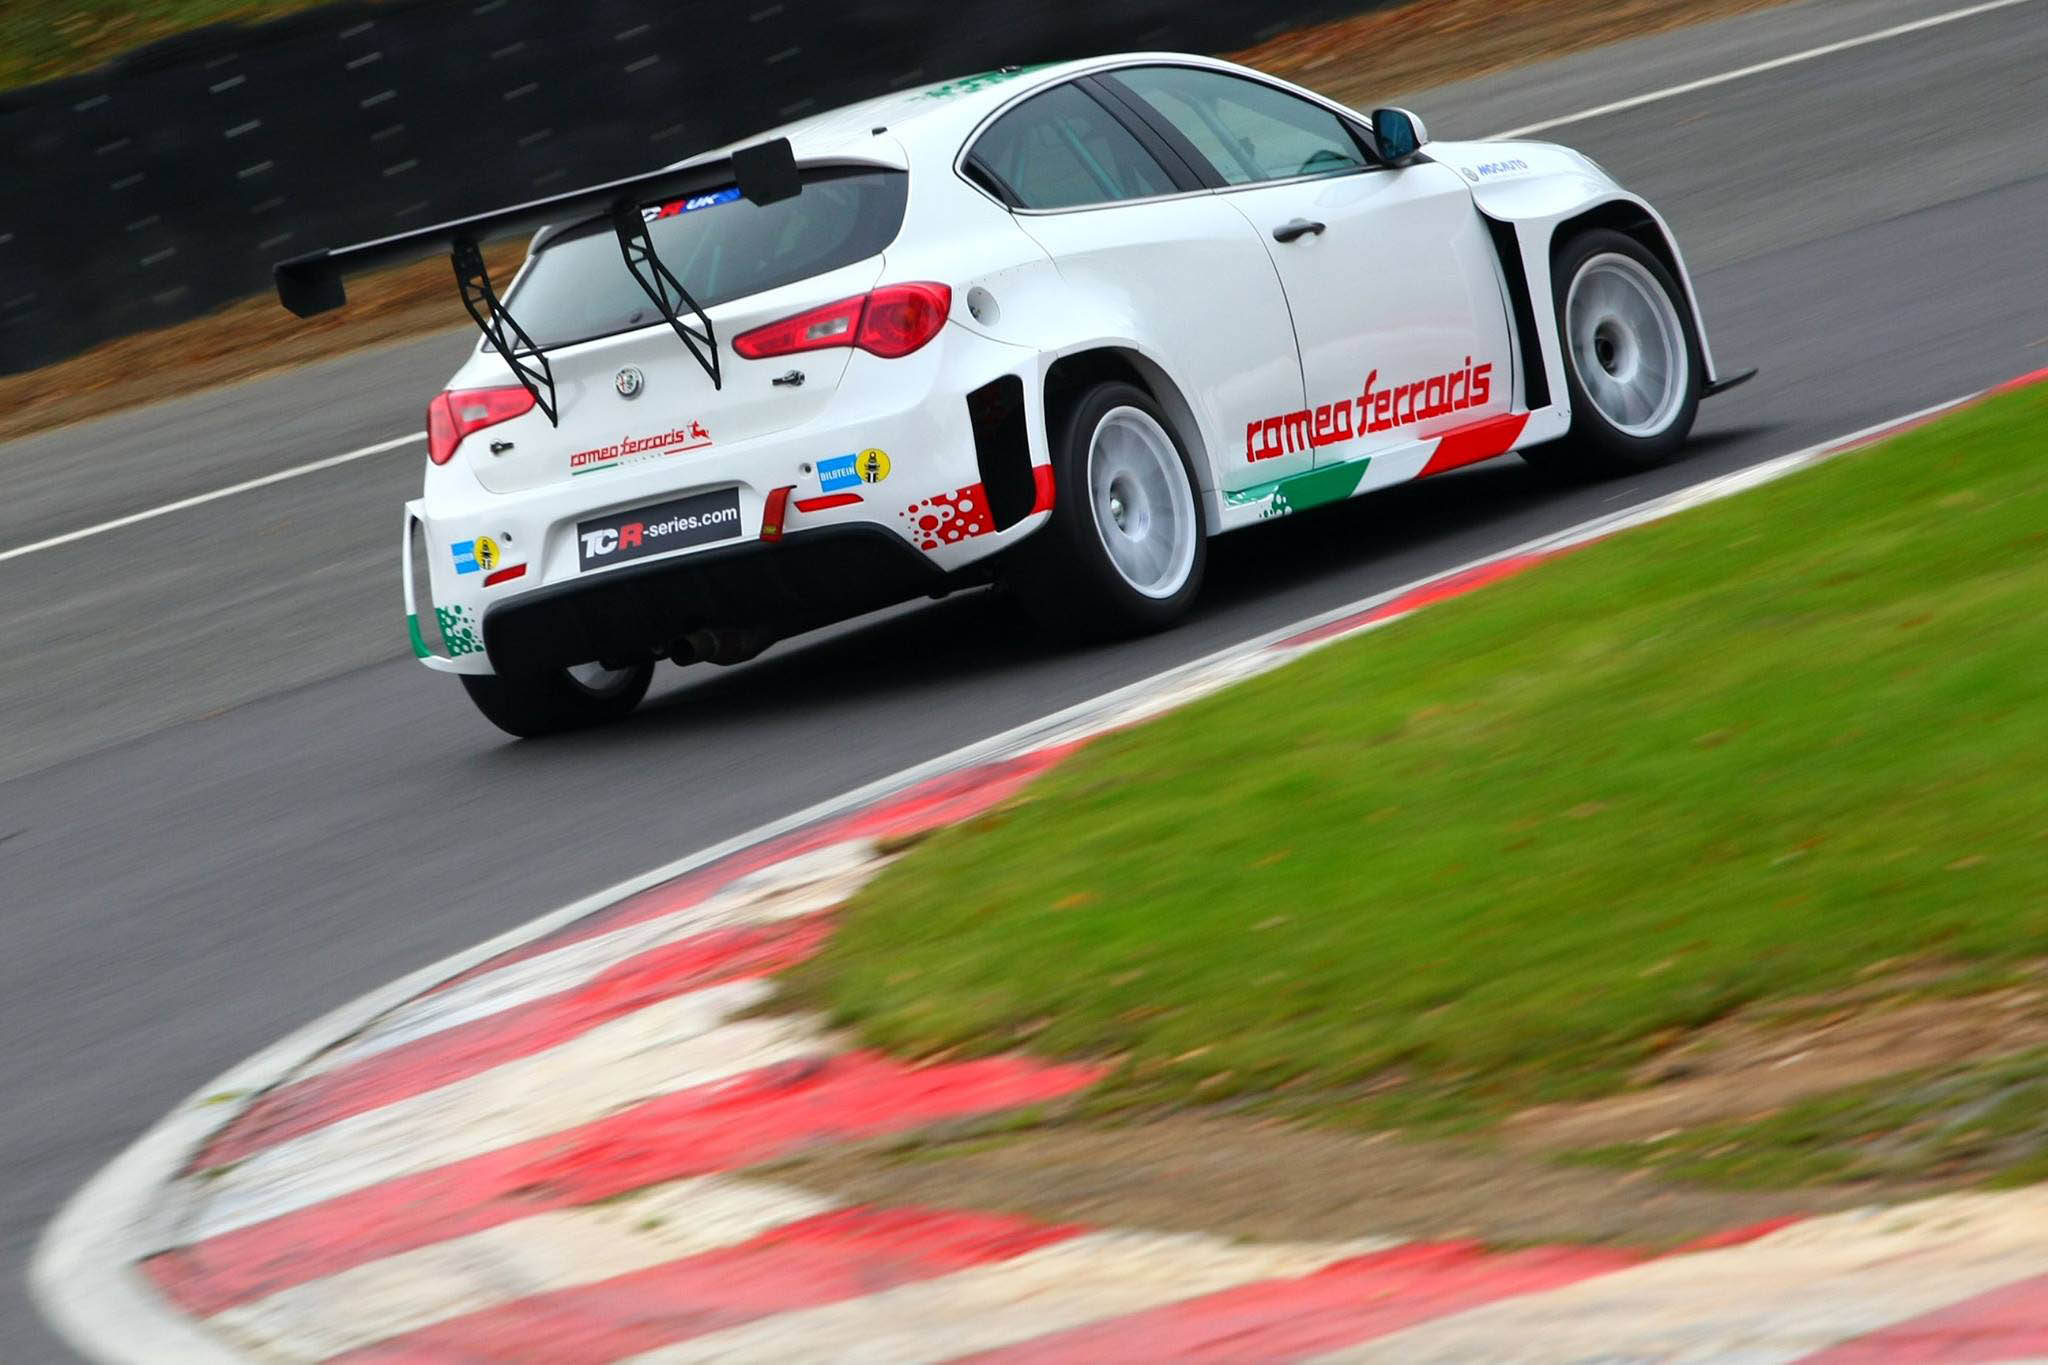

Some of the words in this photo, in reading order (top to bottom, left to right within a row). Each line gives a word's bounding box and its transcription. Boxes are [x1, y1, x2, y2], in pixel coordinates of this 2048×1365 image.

[1246, 398, 1354, 463] romeo
[1356, 355, 1493, 438] ferraris
[570, 445, 619, 468] romeo
[619, 428, 684, 457] ferraris
[580, 506, 738, 559] TCR-series.com
